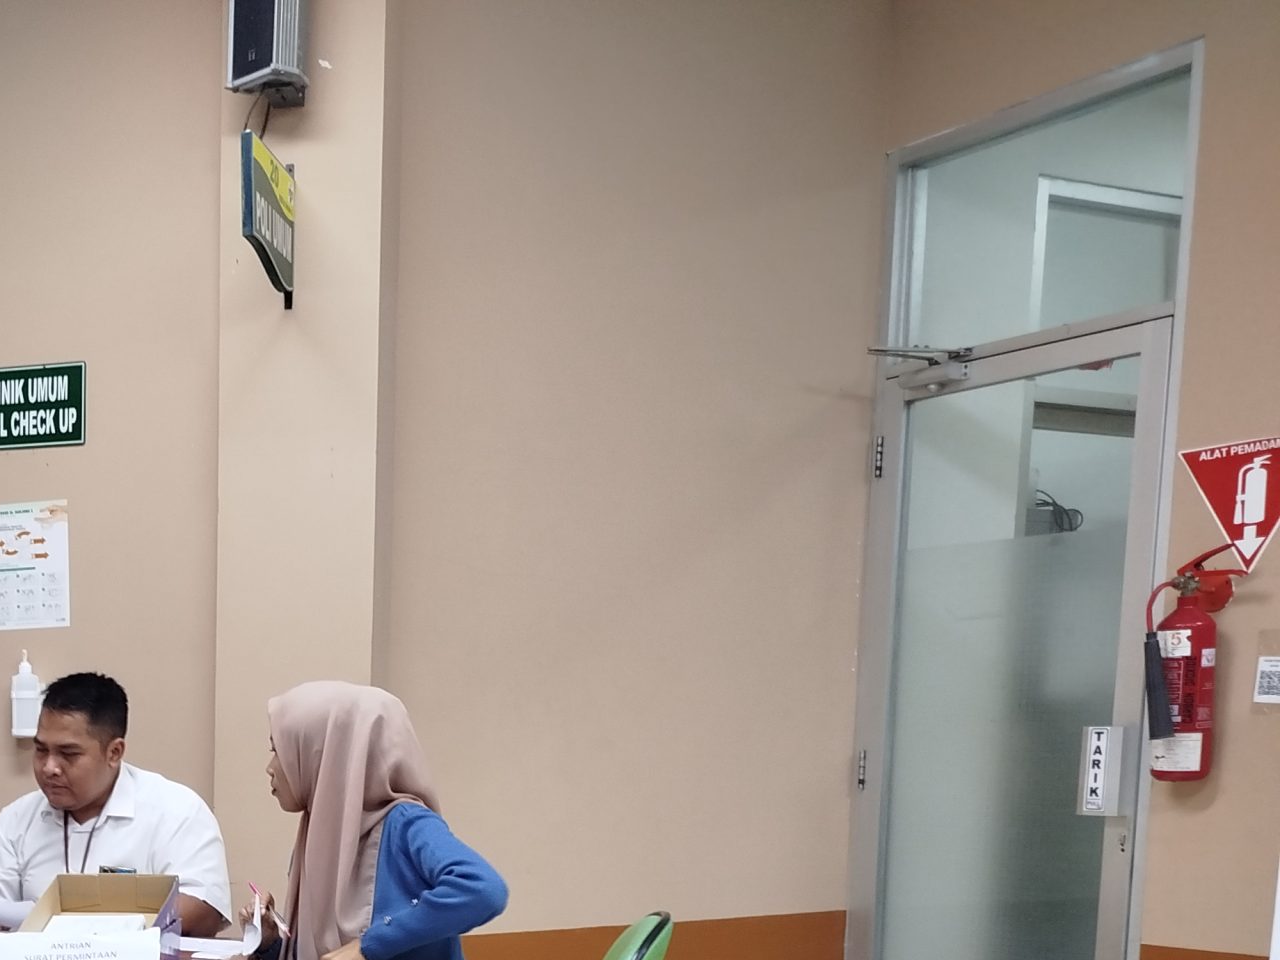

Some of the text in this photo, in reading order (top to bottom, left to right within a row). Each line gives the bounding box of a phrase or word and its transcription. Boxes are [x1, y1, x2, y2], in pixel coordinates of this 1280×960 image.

[28, 375, 69, 404] UMUM
[10, 408, 56, 437] CHECK
[59, 407, 78, 433] UP
[1199, 447, 1229, 461] ALAT
[1089, 731, 1105, 797] TARIK
[51, 942, 92, 950] ANTRIAN
